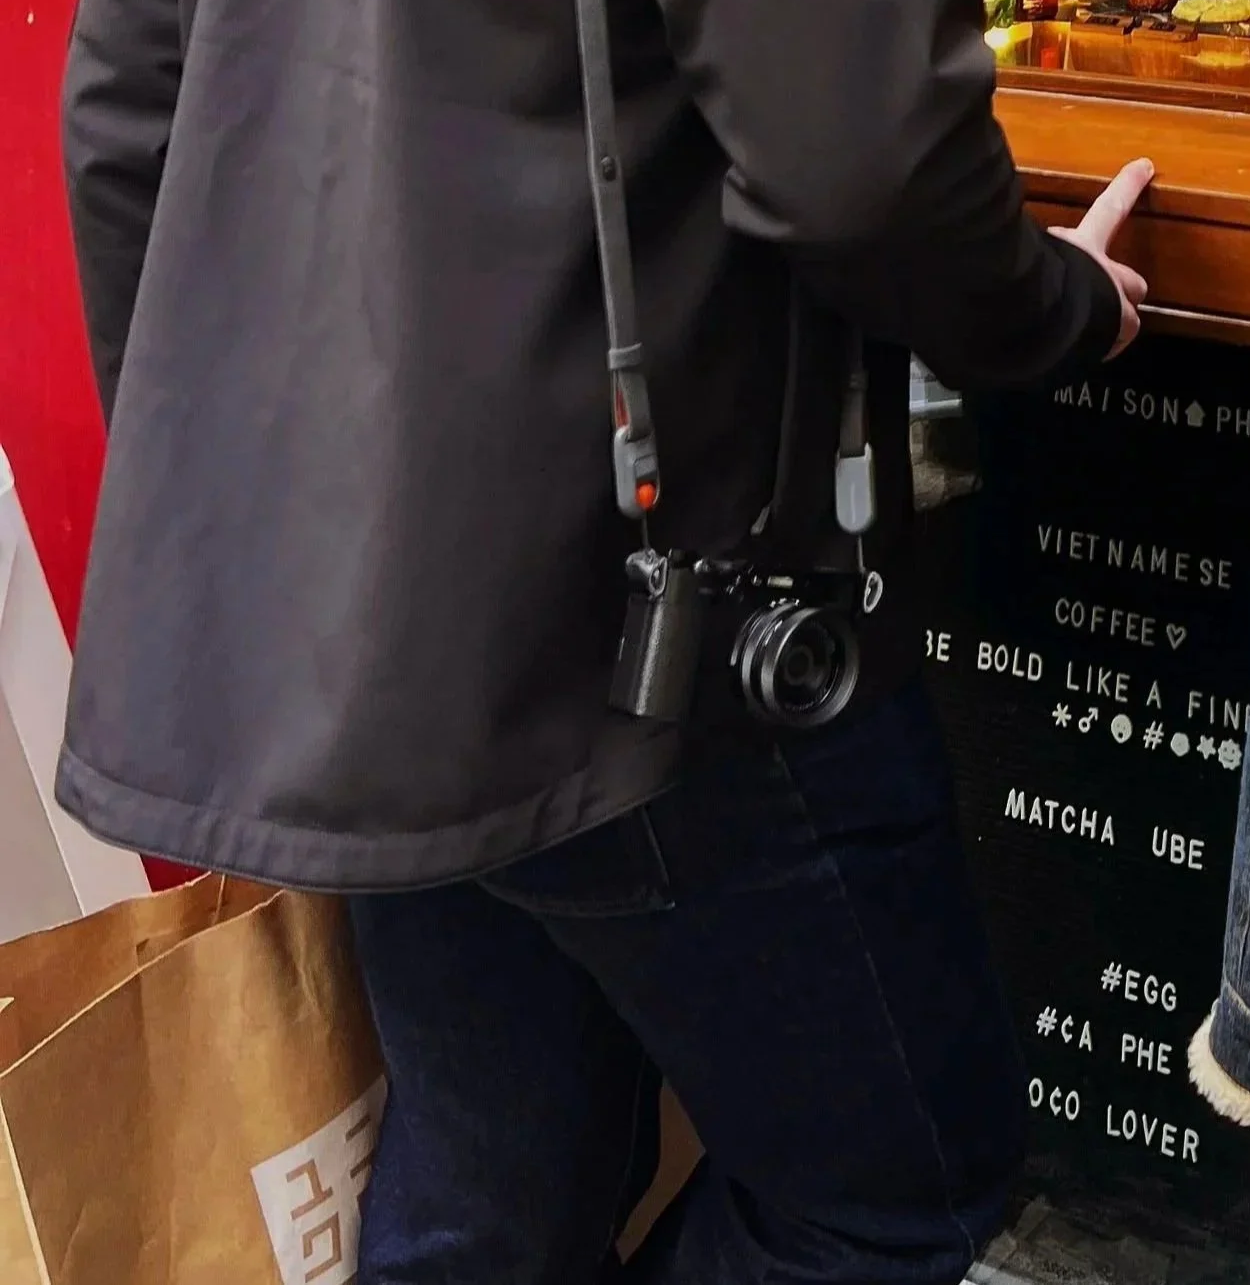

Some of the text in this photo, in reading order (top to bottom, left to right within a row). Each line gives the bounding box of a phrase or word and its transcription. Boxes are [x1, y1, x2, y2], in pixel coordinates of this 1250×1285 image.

[1055, 381, 1179, 425] MAISON
[1038, 524, 1232, 589] VIETNAMESE
[1055, 598, 1155, 646] COFFEE
[978, 641, 1043, 681] BOLD
[1066, 661, 1130, 703] LIKE
[1146, 681, 1162, 709] A
[1005, 788, 1205, 871] MATCHA UBE
[1101, 961, 1177, 1012] #EGG
[1121, 1033, 1173, 1075] PHE
[1106, 1104, 1200, 1164] LOVER
